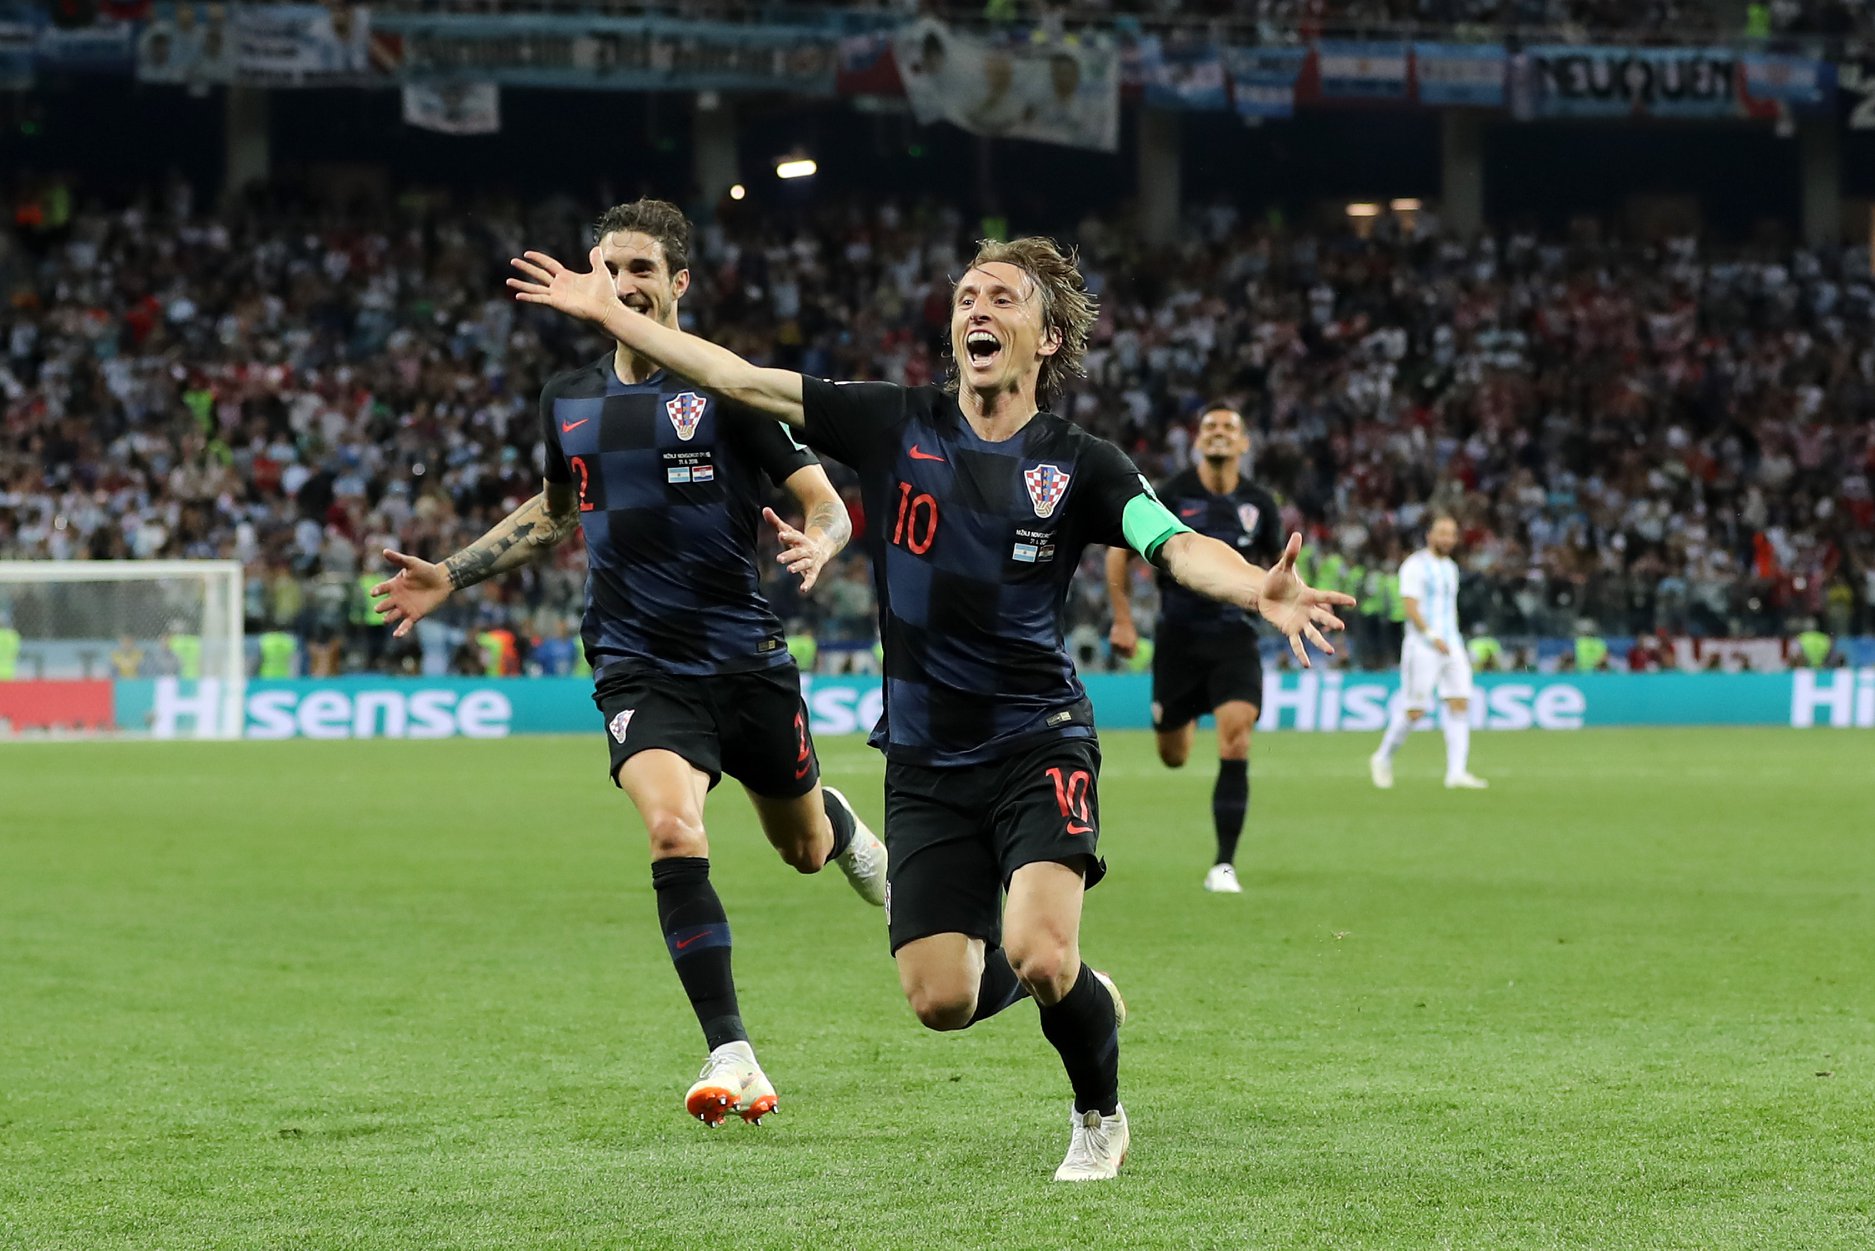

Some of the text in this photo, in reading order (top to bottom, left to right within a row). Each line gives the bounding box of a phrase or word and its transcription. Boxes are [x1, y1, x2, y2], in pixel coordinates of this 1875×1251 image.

[571, 456, 595, 511] 2
[893, 481, 939, 555] 10
[1045, 767, 1090, 823] 10
